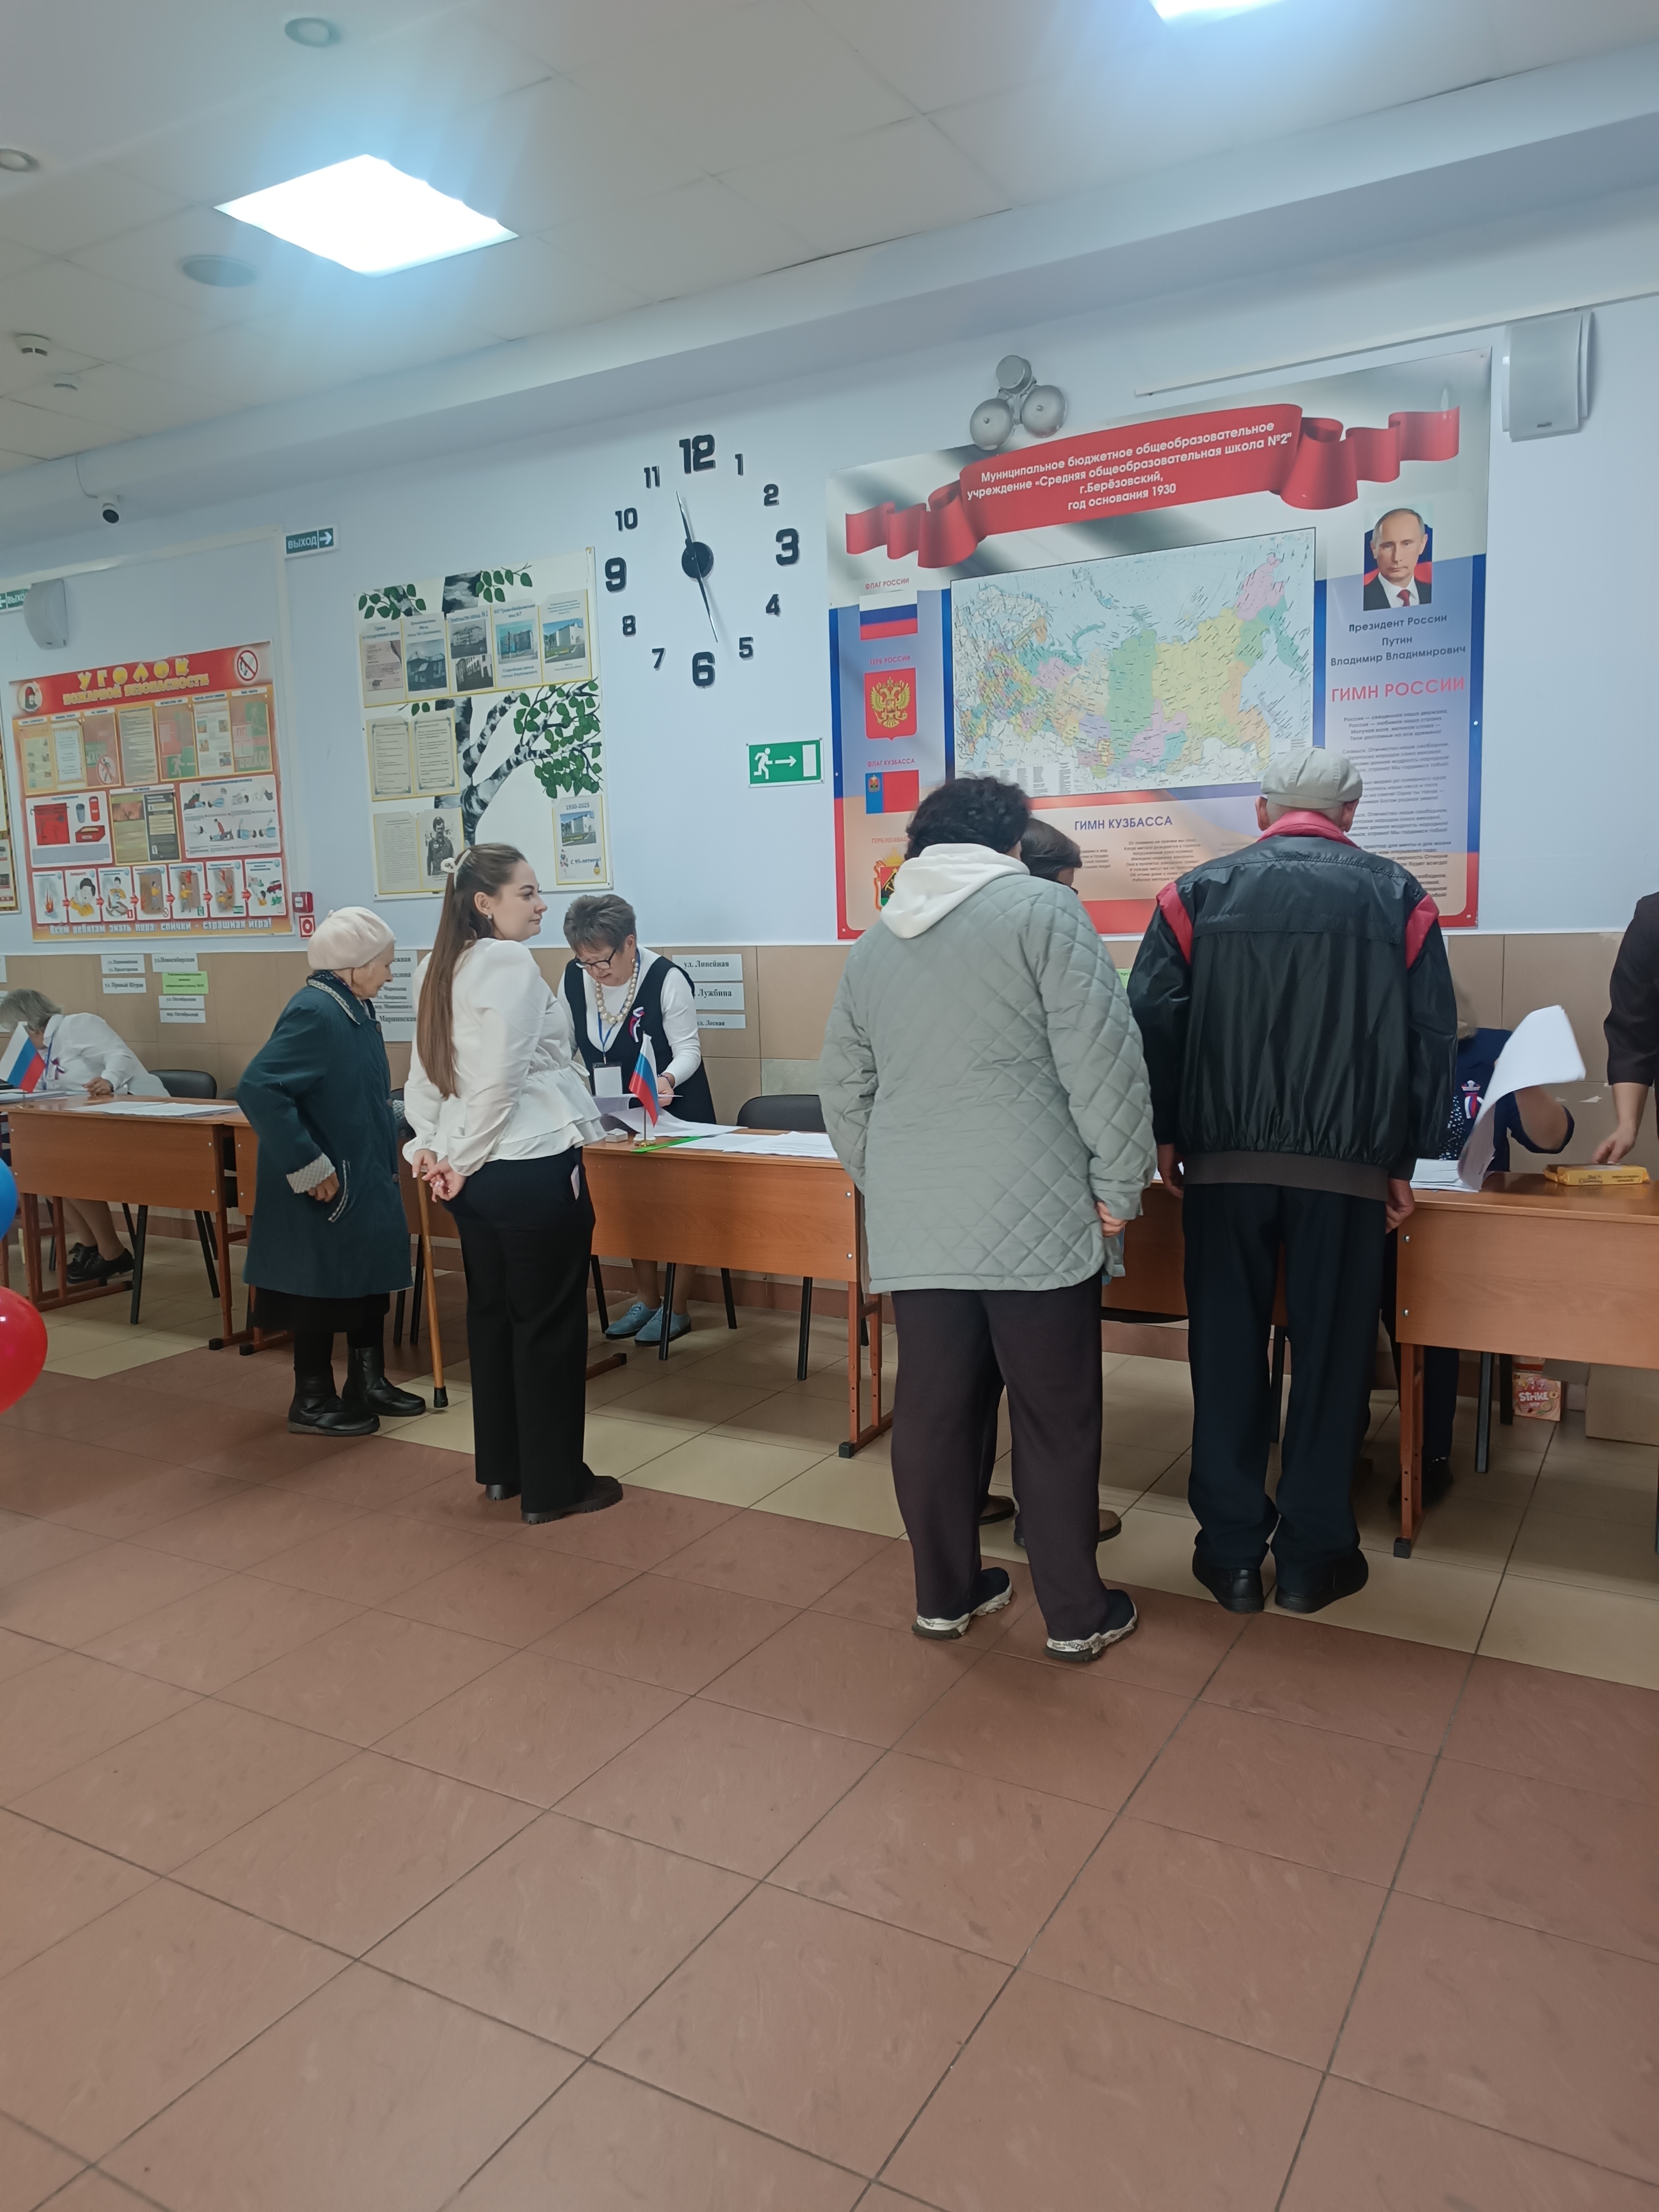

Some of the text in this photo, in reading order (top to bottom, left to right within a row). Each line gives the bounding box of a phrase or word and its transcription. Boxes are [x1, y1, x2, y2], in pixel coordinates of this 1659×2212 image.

[679, 435, 715, 474] 12
[981, 422, 1275, 483] Муниципальное бюджетное общеобразовательное
[735, 453, 743, 476] 1
[967, 481, 1032, 500] учреждение
[1035, 471, 1086, 487] «Средняя
[1088, 447, 1221, 479] общеобразовательная
[1224, 439, 1264, 455] школа
[644, 466, 660, 488] 11
[1079, 471, 1163, 494] г.Берёзовский,
[763, 484, 779, 507] 2
[1068, 483, 1177, 510] год основания 1930
[615, 507, 638, 531] 10
[288, 536, 317, 549] ВЫХОД
[775, 528, 799, 565] 3
[605, 557, 627, 592] 9
[883, 578, 909, 587] РОССИИ
[7, 593, 27, 604] ВЫХО
[765, 593, 780, 616] 4
[622, 614, 636, 637] 8
[1349, 615, 1447, 633] Президент России
[739, 637, 753, 660] 5
[1382, 637, 1412, 647] Путин
[651, 647, 665, 670] 7
[1331, 646, 1465, 666] Владимир Владимирович
[78, 657, 189, 691] УГОЛОК
[692, 651, 714, 687] 6
[63, 674, 210, 705] ПОЖАРНОЙ БЕЗОПАСНОСТИ
[1332, 676, 1464, 702] ГИМН РОССИИ
[1074, 816, 1172, 830] ГИМН КУЗБАССА
[50, 925, 69, 935] Всем
[73, 925, 105, 934] ребятам
[109, 924, 132, 933] знать
[160, 922, 191, 931] спички
[203, 920, 245, 930] страшная
[249, 917, 272, 929] игра!
[697, 989, 732, 998] Лужбина
